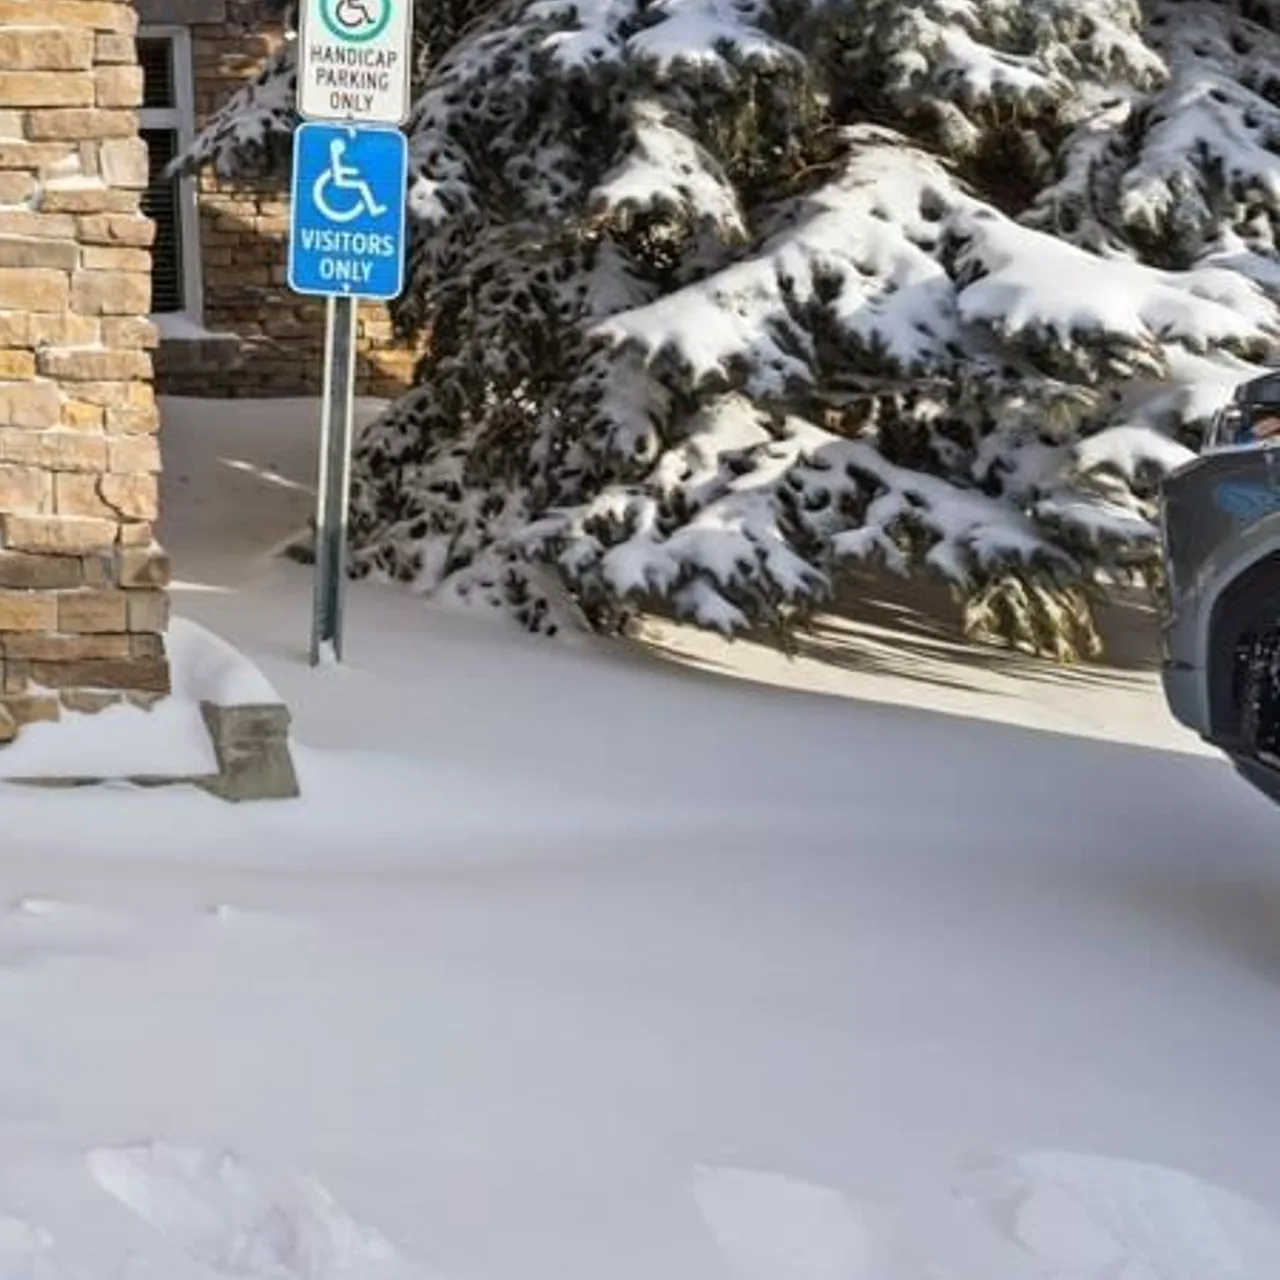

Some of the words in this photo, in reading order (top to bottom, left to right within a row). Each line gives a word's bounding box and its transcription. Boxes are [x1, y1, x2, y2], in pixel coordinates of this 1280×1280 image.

[310, 45, 397, 69] HANDICAP
[315, 67, 389, 91] PARKING
[329, 91, 374, 113] ONLY
[301, 228, 394, 257] VISITORS
[319, 258, 374, 282] ONLY
